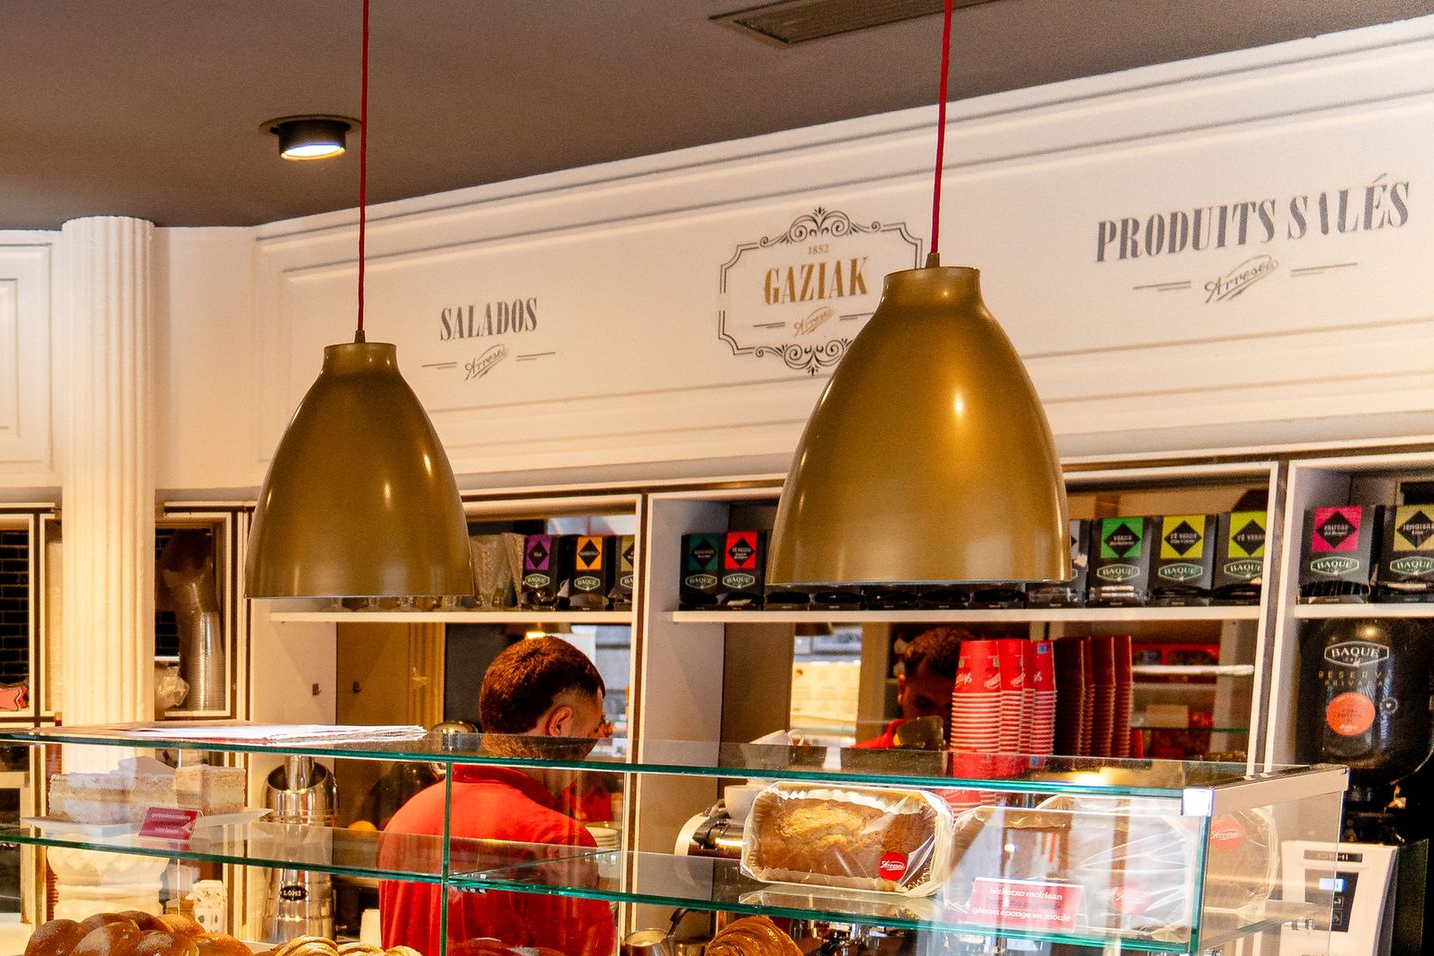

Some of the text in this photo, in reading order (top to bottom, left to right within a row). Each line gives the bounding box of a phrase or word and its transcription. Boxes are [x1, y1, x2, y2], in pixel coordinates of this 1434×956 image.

[1096, 172, 1410, 263] PRODUITS SALÉS
[808, 244, 830, 256] 1852
[764, 256, 869, 305] GAZIAK
[439, 296, 538, 341] SALADOS
